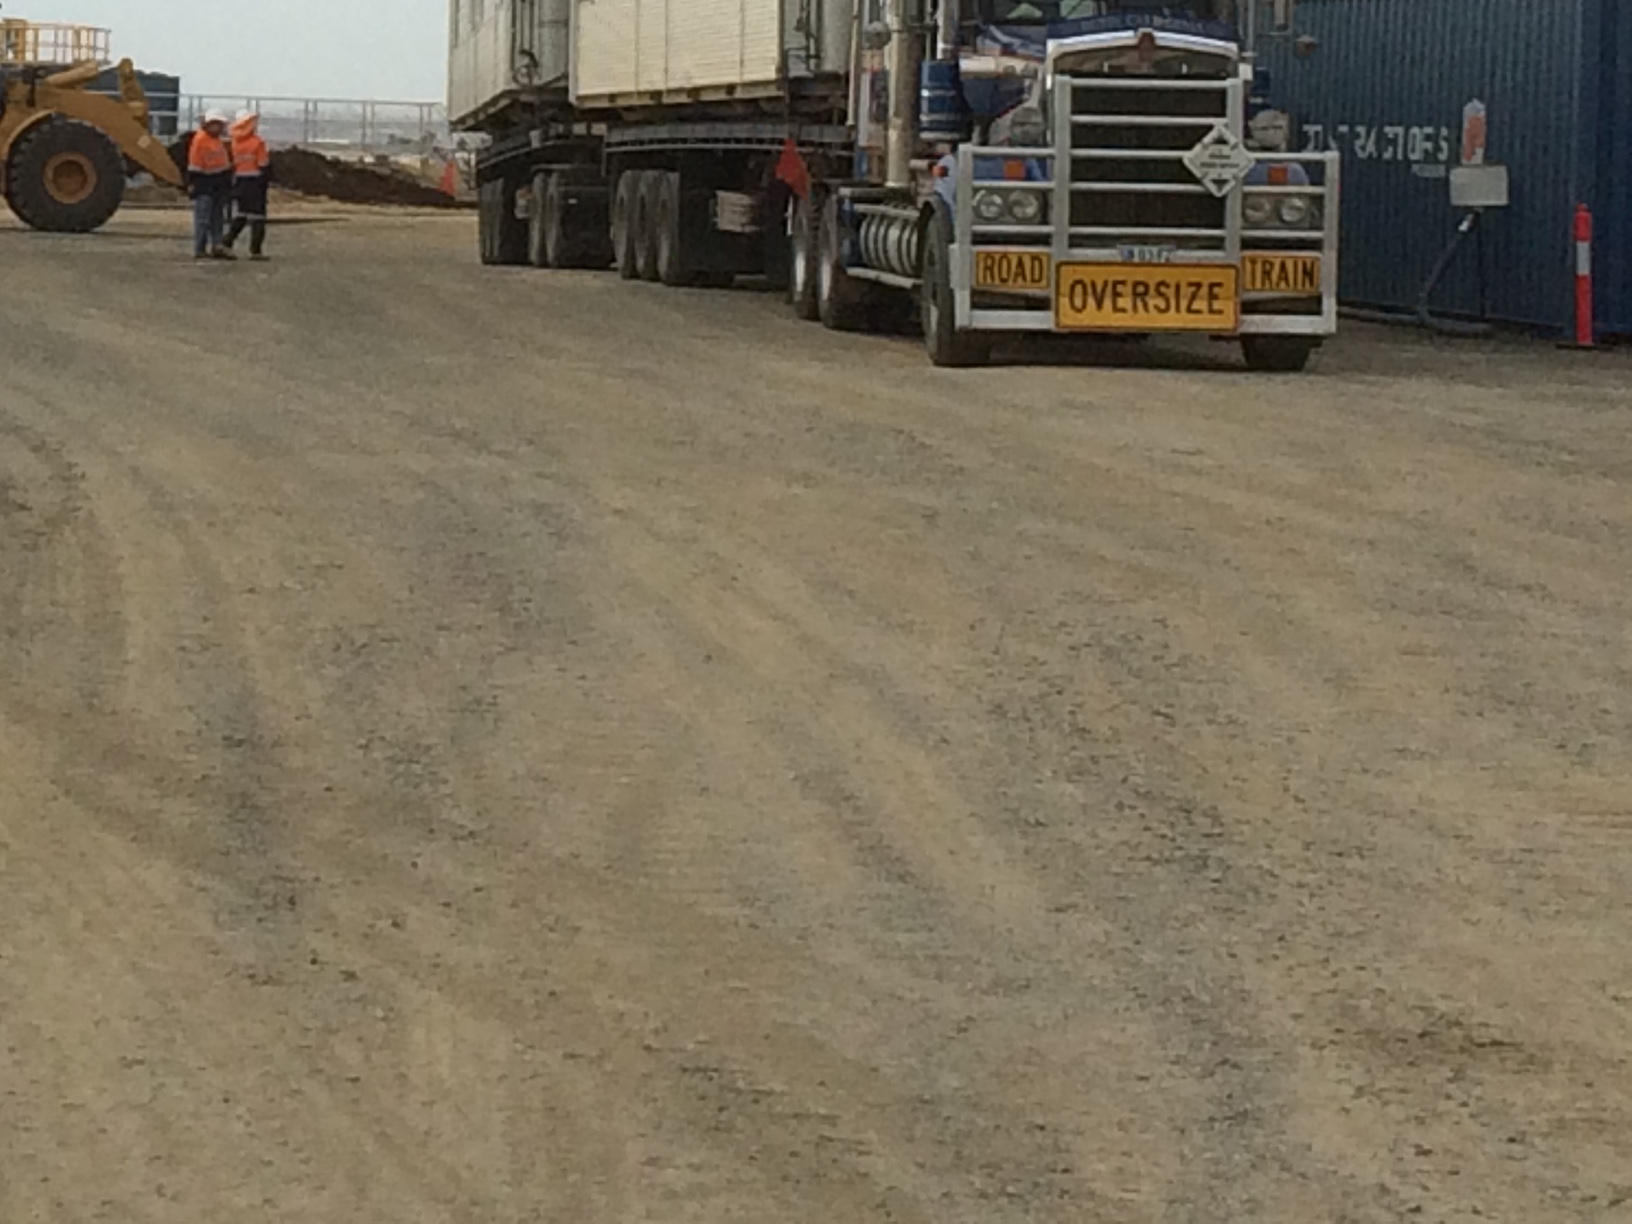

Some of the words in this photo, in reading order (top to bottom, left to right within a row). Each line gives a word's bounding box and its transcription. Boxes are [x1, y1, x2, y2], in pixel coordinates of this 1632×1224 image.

[982, 254, 1044, 283] ROAD
[1249, 259, 1315, 288] TRAIN
[1069, 279, 1225, 314] OVERSIZE
